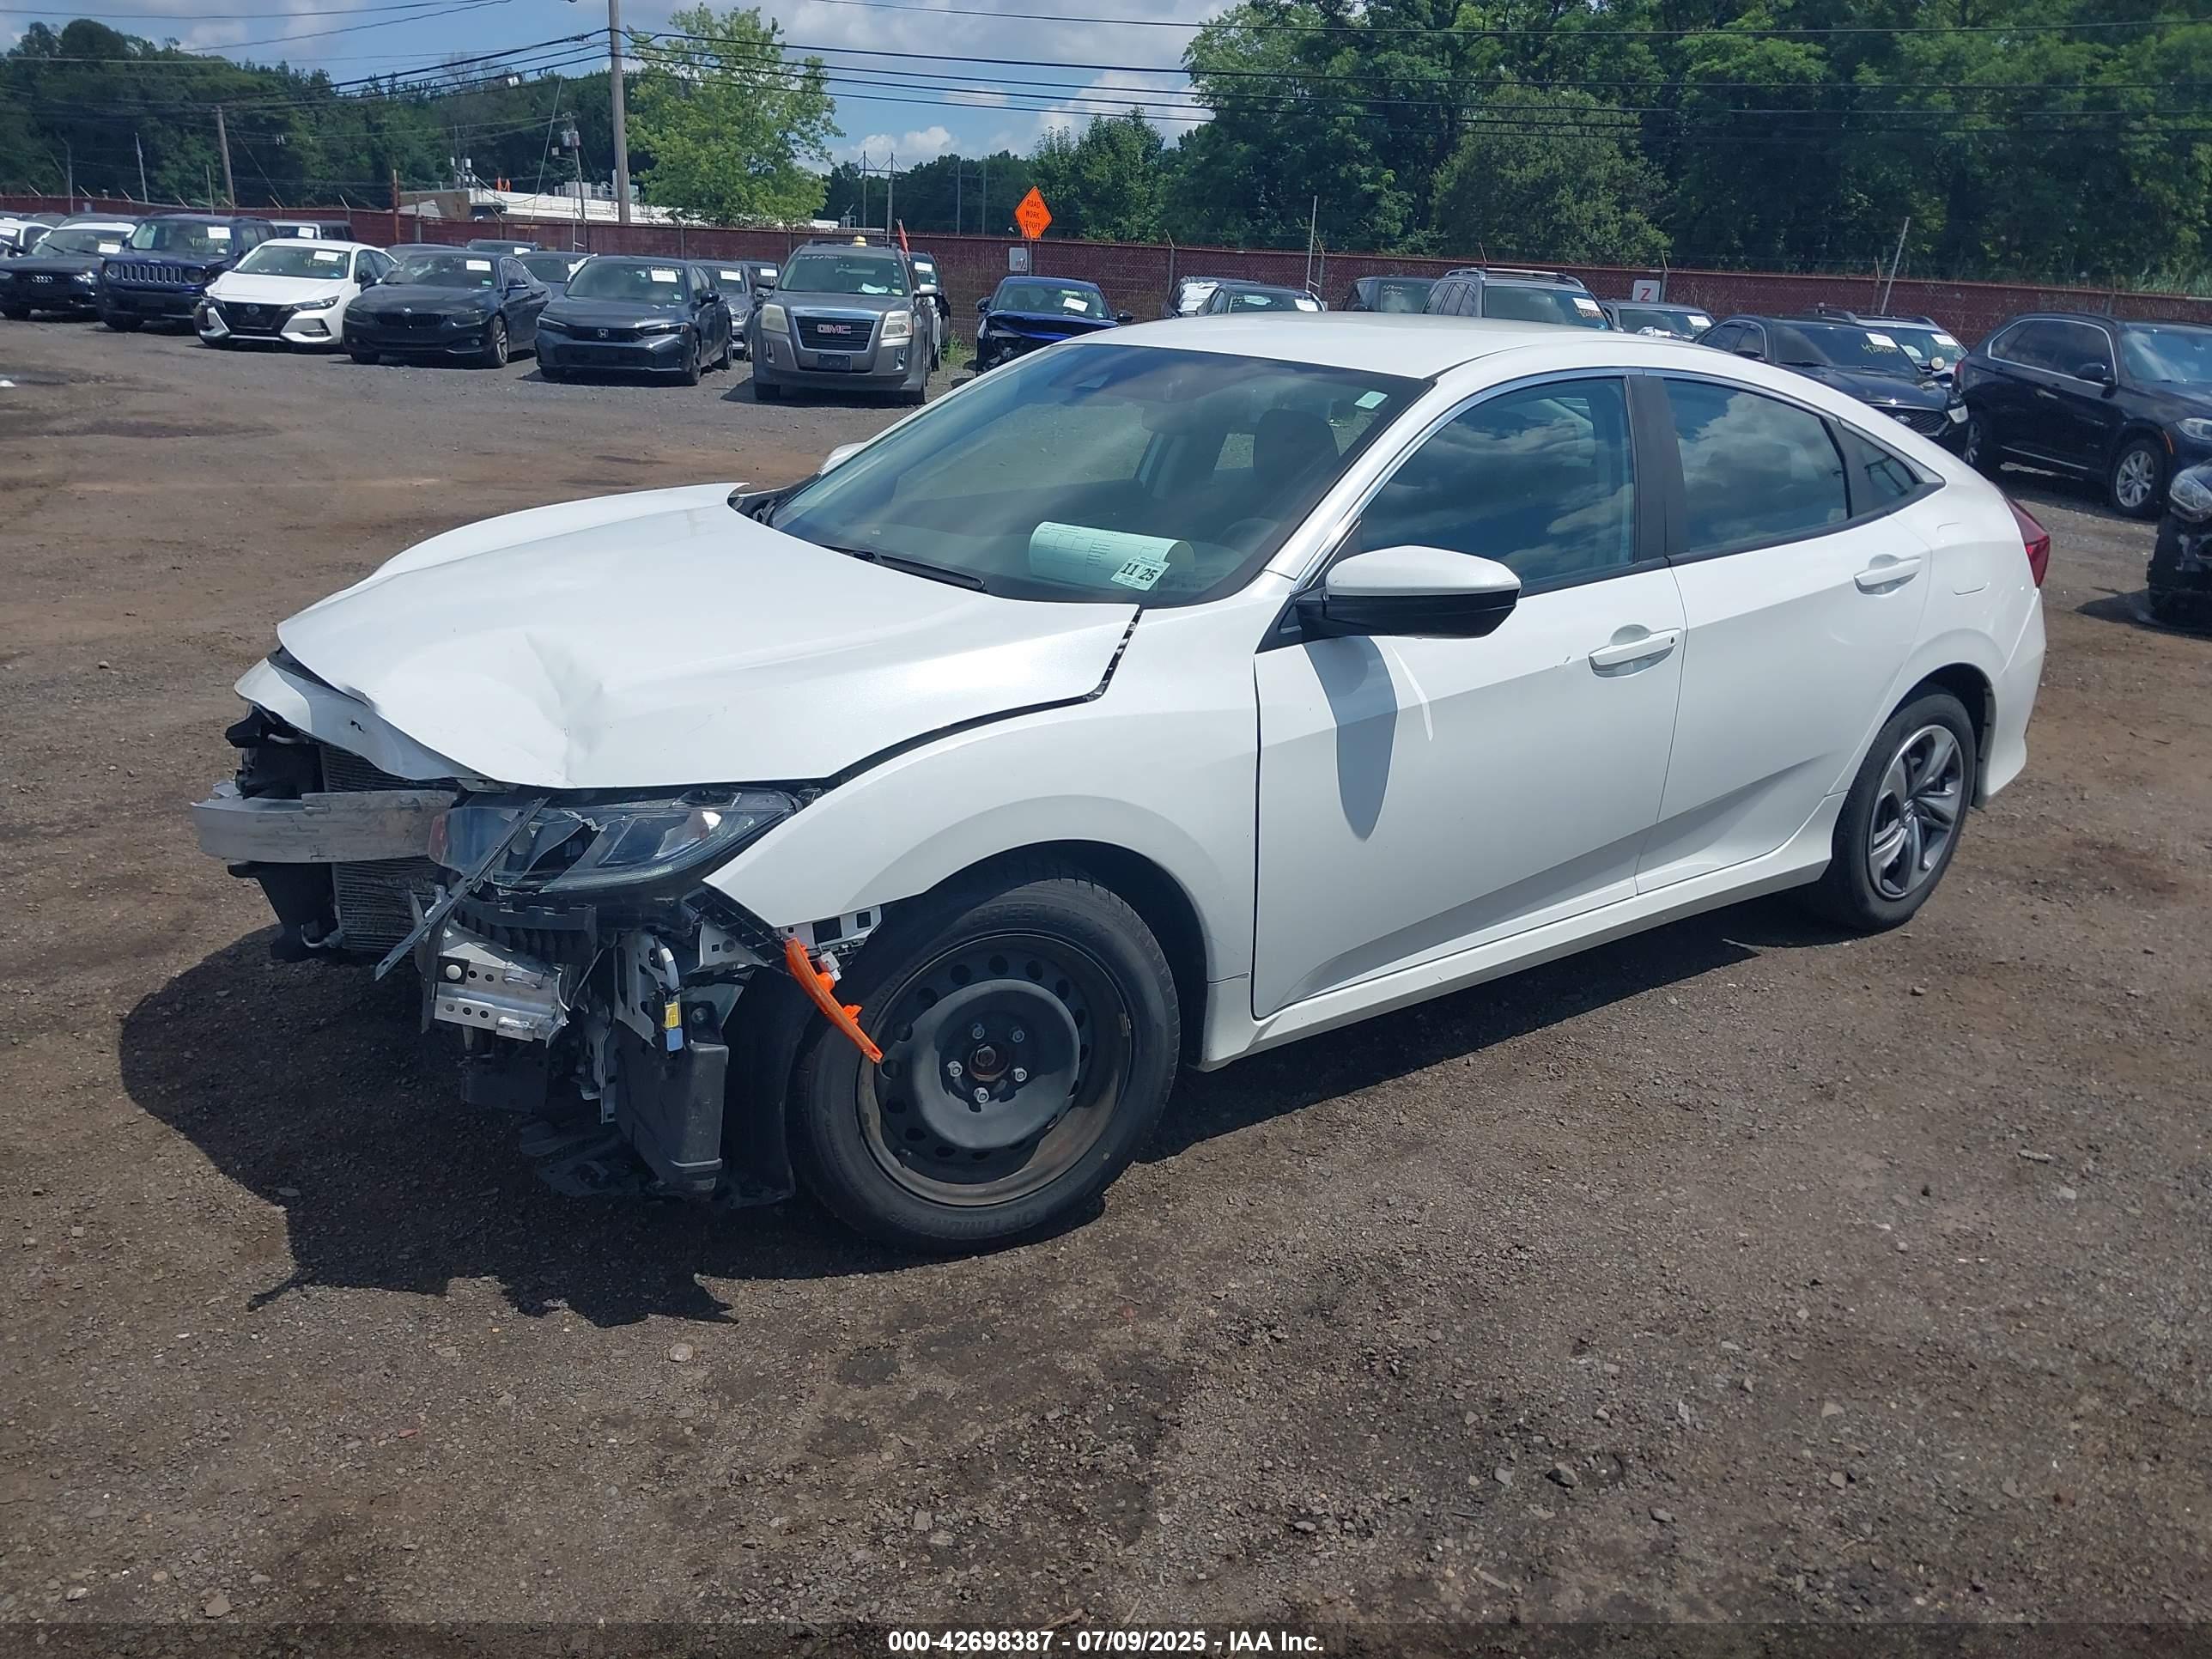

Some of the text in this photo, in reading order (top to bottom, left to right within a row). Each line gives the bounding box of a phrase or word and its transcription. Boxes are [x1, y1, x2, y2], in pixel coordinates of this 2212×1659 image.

[1026, 199, 1041, 209] ROAD
[1025, 210, 1040, 220] WORK
[817, 324, 851, 335] GMC
[1121, 562, 1139, 575] 11
[1138, 568, 1158, 581] 25
